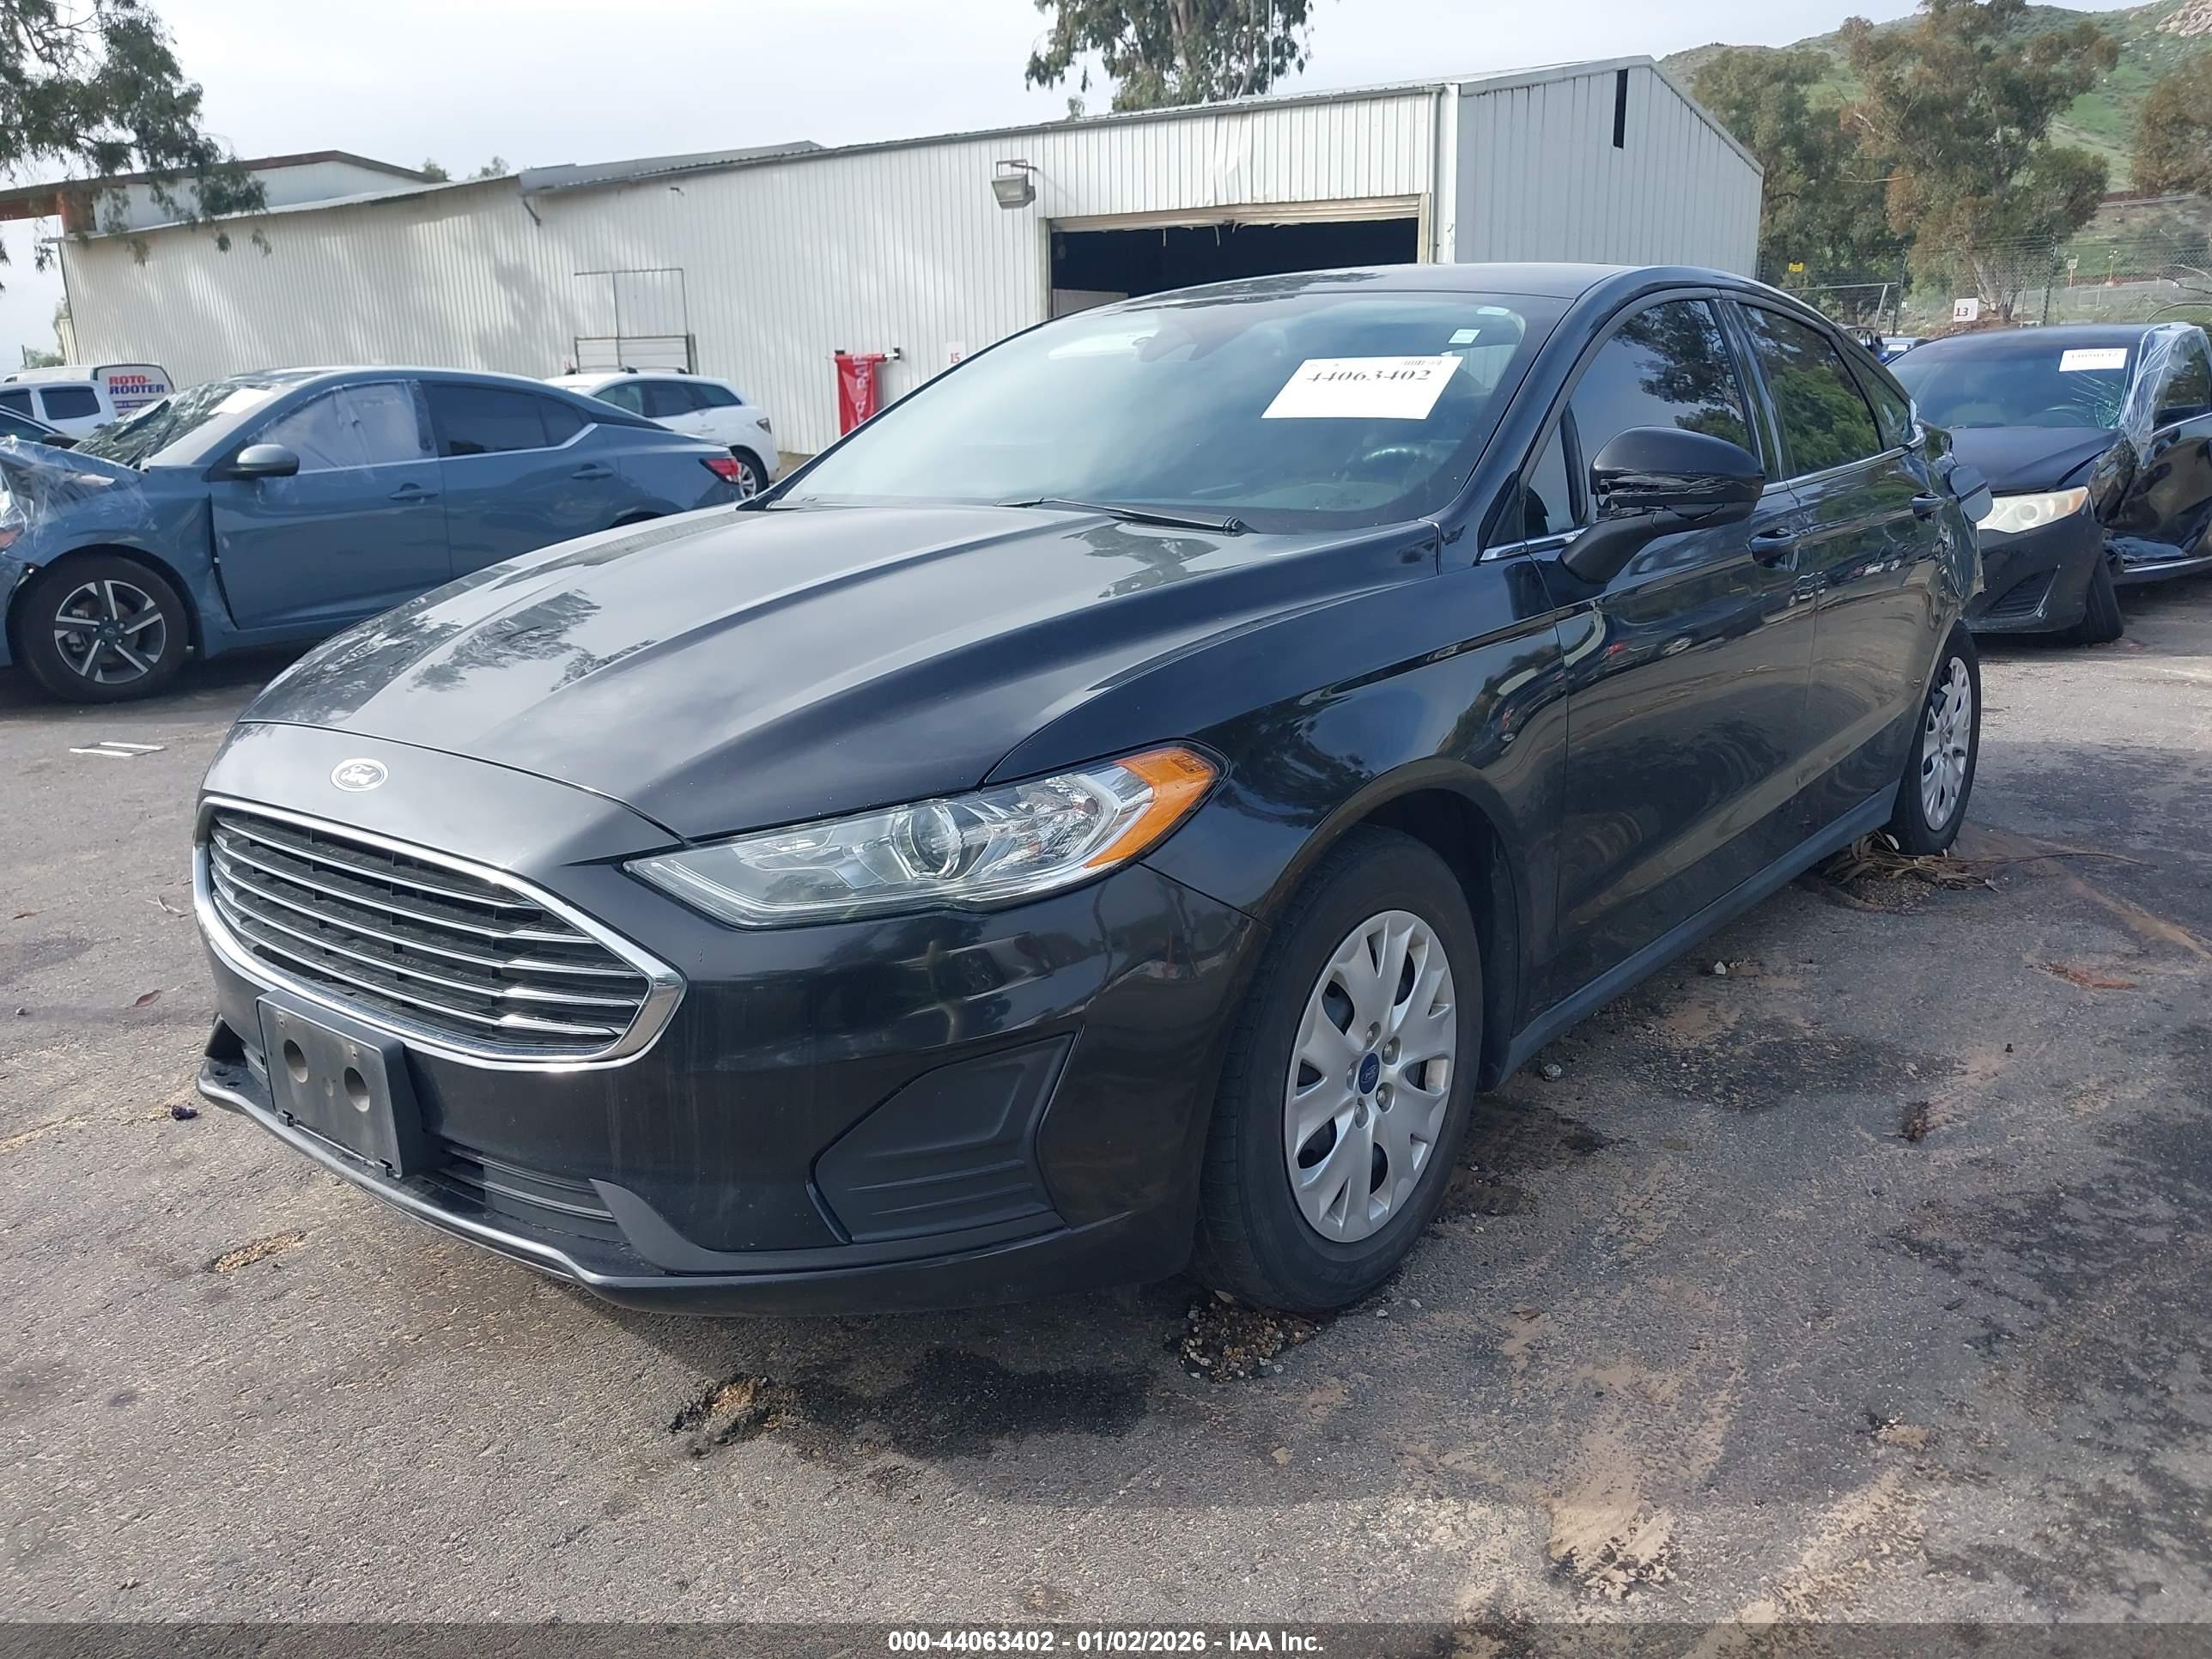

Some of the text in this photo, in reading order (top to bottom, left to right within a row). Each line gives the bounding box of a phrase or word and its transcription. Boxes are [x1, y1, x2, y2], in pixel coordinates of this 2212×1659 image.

[1954, 307, 1969, 317] 13
[950, 352, 960, 364] 15
[1306, 369, 1432, 383] 44063402
[110, 384, 165, 395] ROOTER
